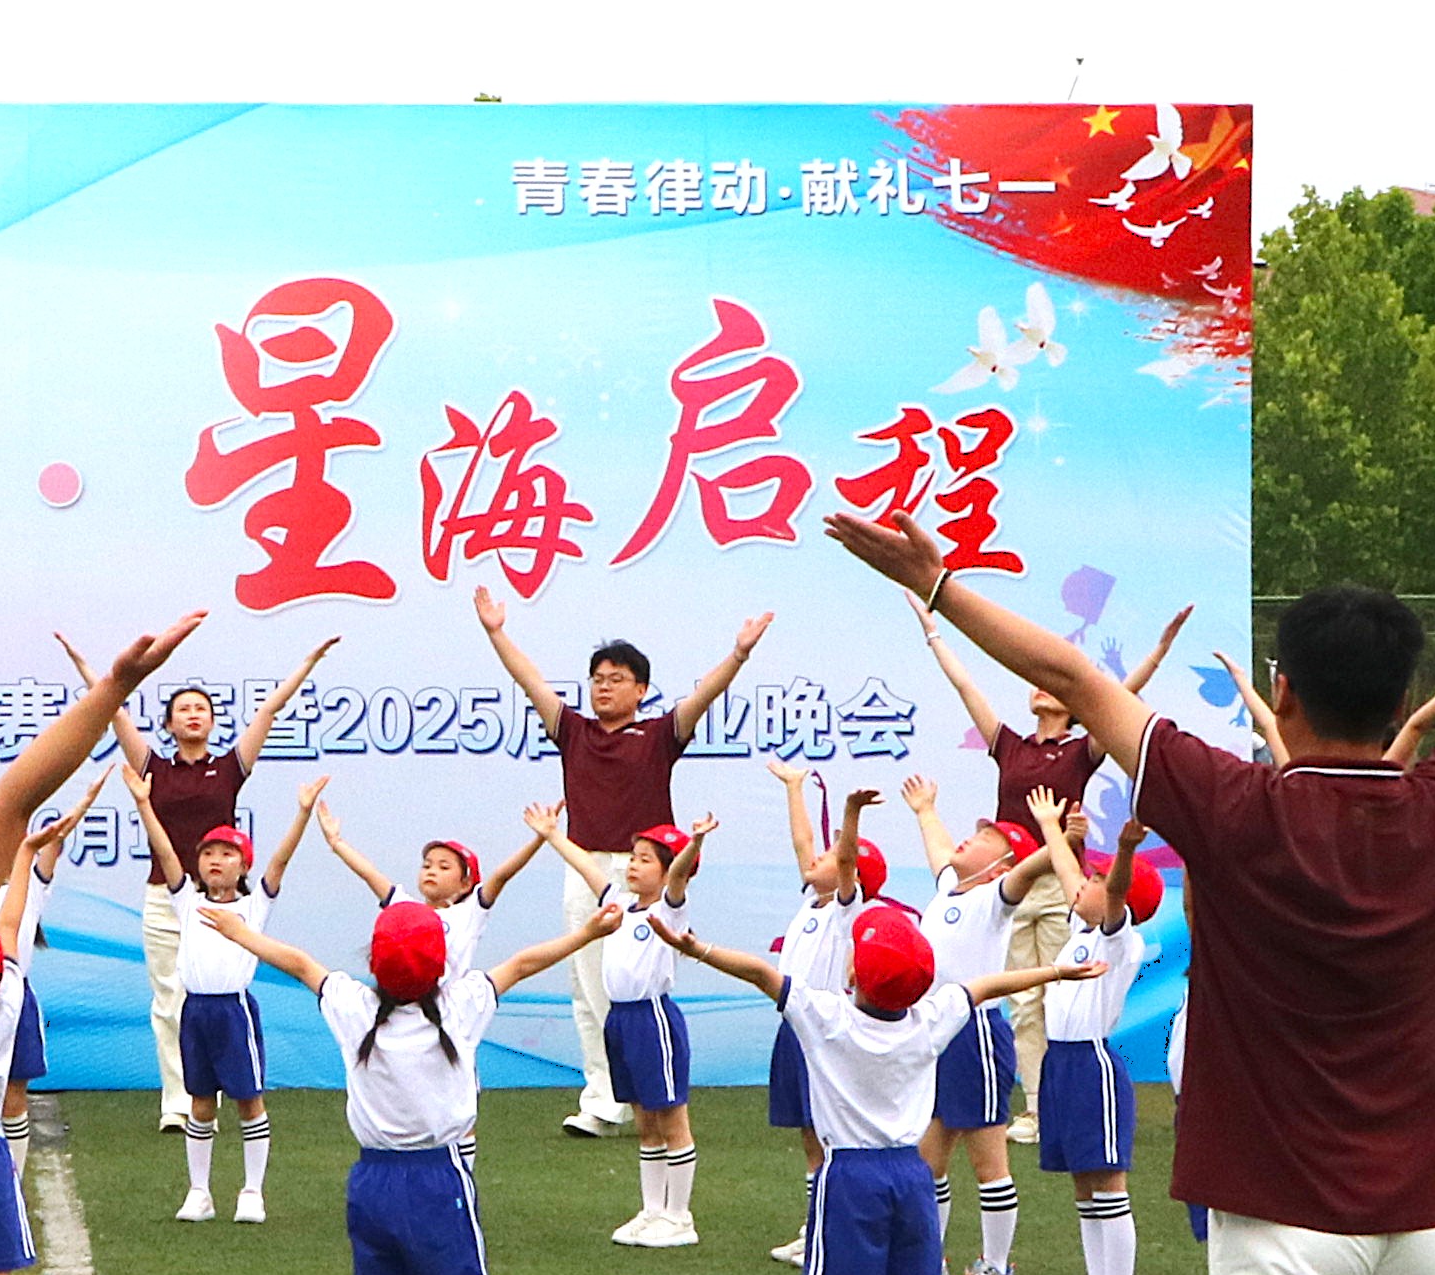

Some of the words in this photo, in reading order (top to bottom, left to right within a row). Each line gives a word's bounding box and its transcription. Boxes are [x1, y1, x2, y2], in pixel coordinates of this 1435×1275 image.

[511, 157, 1057, 216] 青春律动·献礼七一
